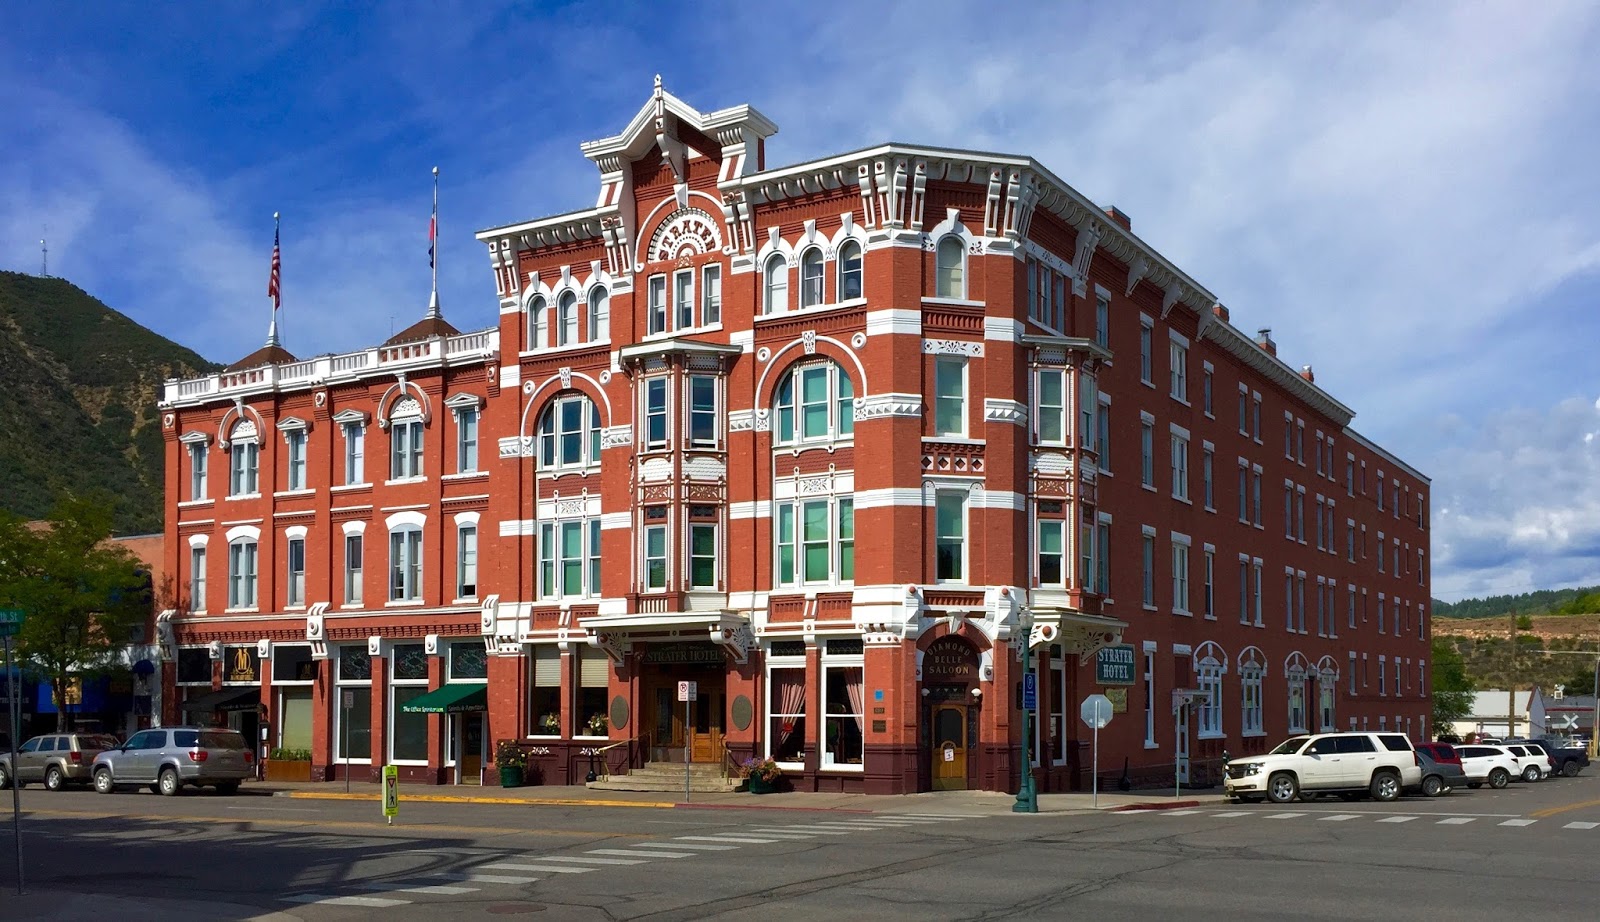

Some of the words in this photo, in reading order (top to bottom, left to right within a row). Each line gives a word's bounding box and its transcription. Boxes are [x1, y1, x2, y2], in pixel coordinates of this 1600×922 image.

[659, 220, 716, 261] STRATER
[647, 651, 687, 661] STRATER
[690, 650, 719, 660] HOTEL
[927, 642, 971, 656] DIAMOND
[1098, 648, 1133, 663] STRATER
[935, 655, 962, 663] BELLE
[930, 666, 969, 674] SALOON
[1103, 664, 1128, 678] HOTEL
